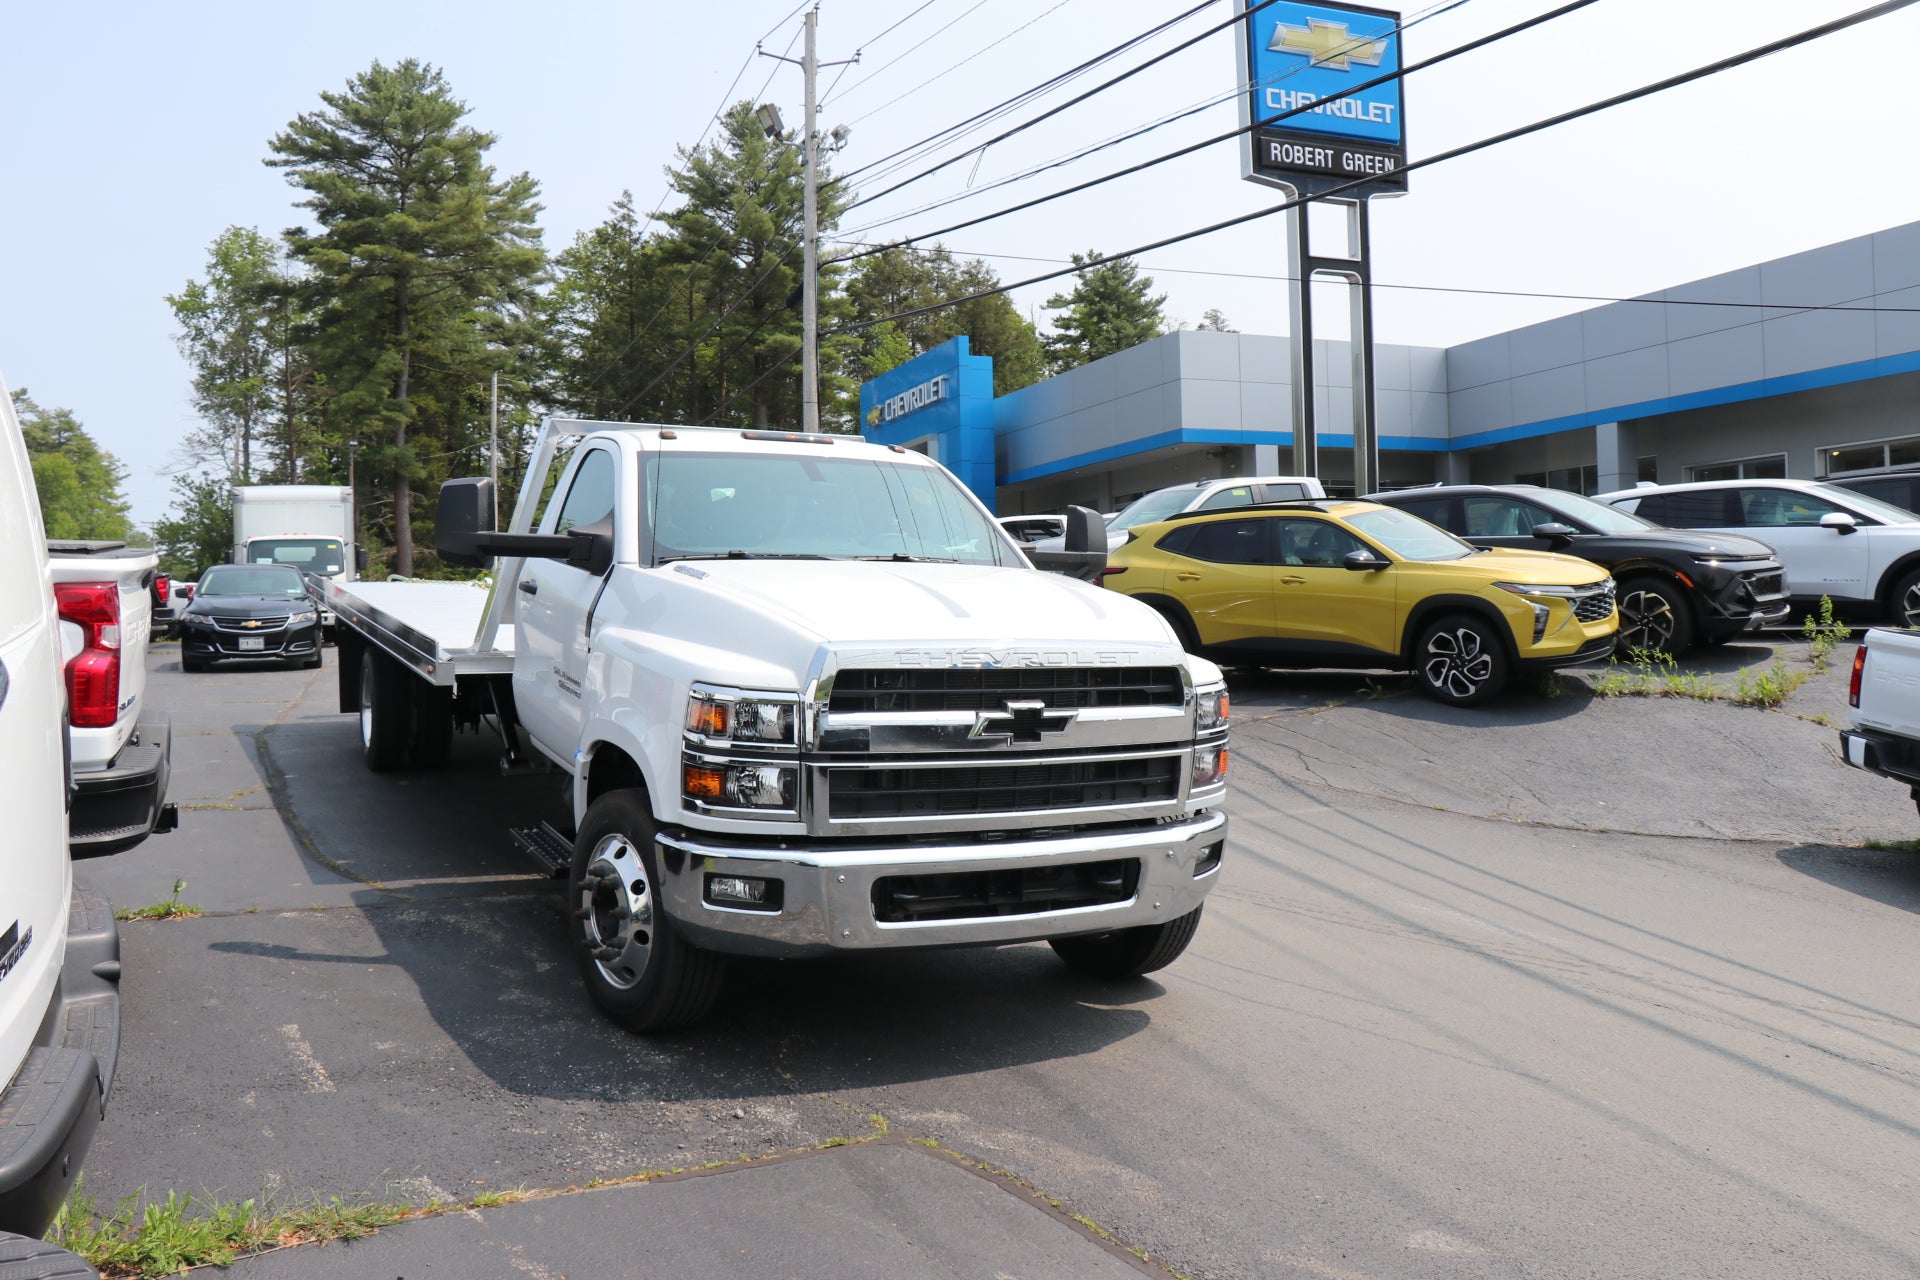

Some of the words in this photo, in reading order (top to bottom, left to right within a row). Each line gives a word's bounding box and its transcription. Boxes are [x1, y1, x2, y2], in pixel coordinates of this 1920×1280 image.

[1266, 87, 1394, 124] CHEVROLET
[1270, 142, 1334, 168] ROBERT
[1342, 152, 1395, 174] GREEN
[885, 374, 948, 421] CHEVROLET
[895, 651, 1139, 667] CHEVROLET
